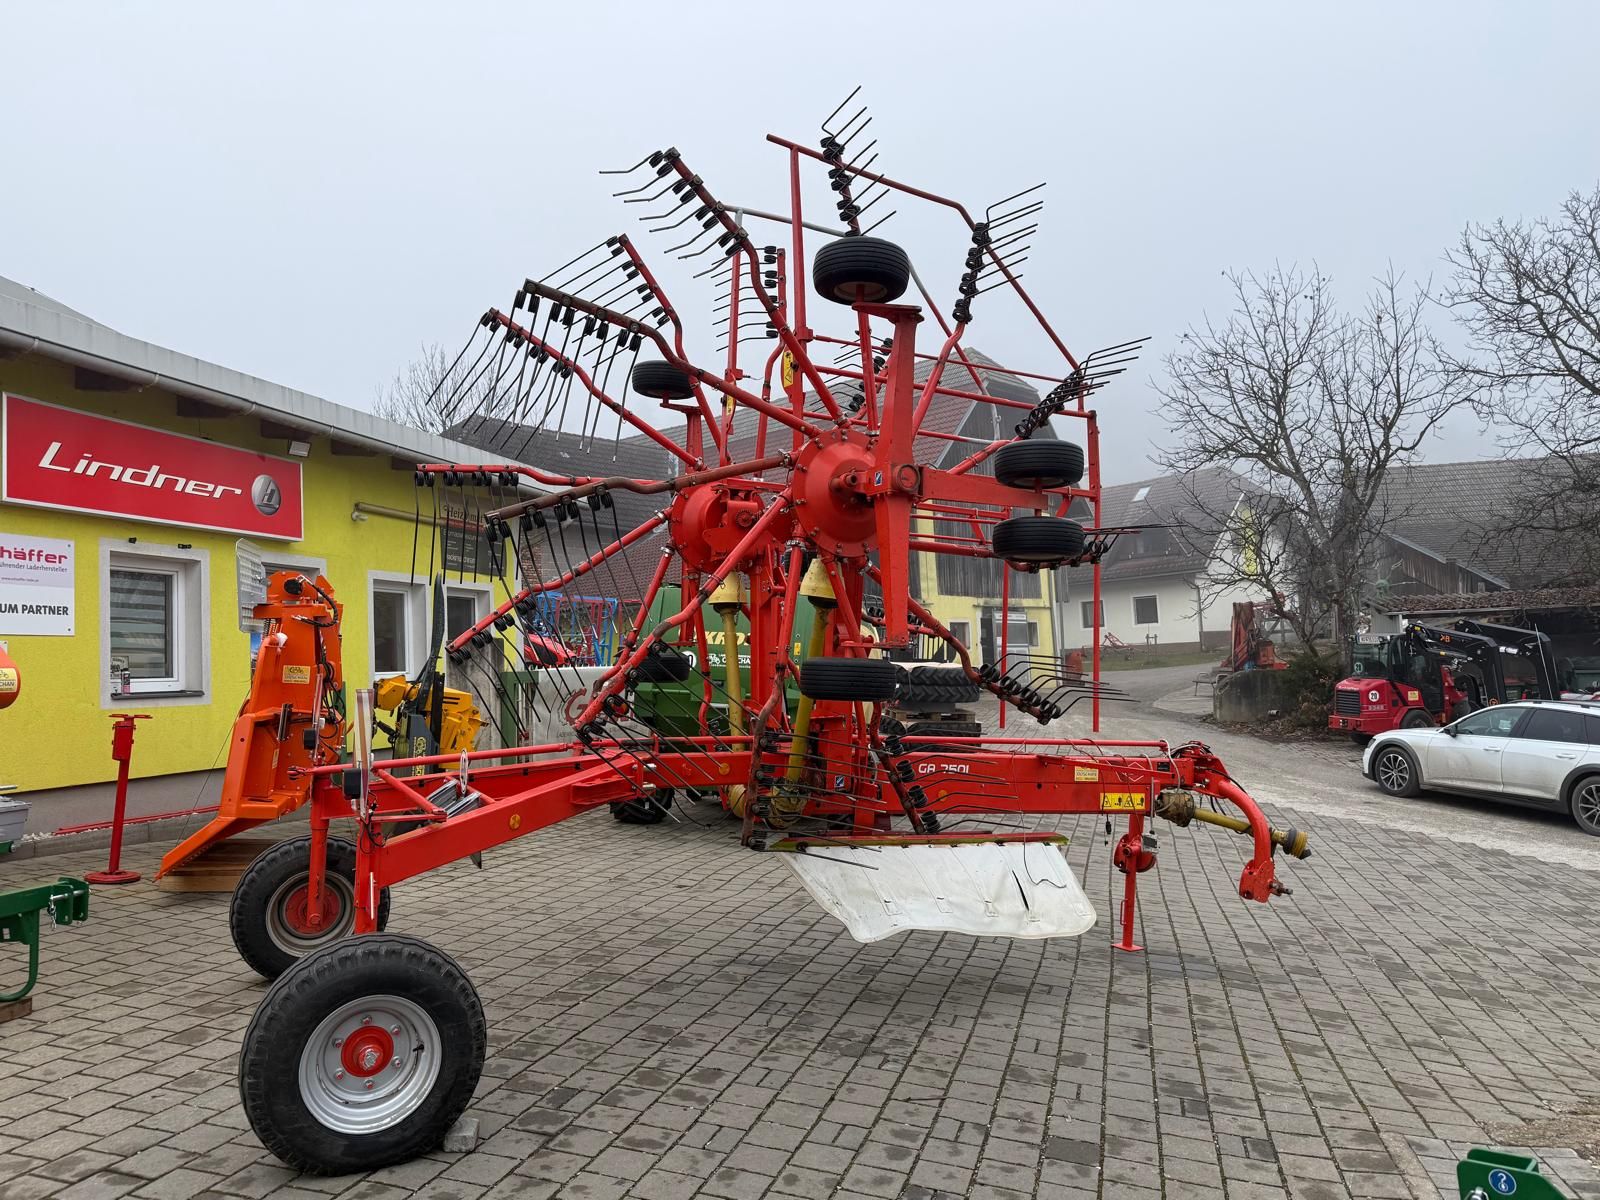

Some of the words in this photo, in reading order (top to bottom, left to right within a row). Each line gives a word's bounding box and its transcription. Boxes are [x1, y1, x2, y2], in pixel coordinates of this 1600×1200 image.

[38, 441, 243, 499] Lindner
[0, 603, 18, 614] UM
[21, 604, 69, 616] PARTNER
[1371, 692, 1378, 700] 20
[918, 763, 936, 774] GA
